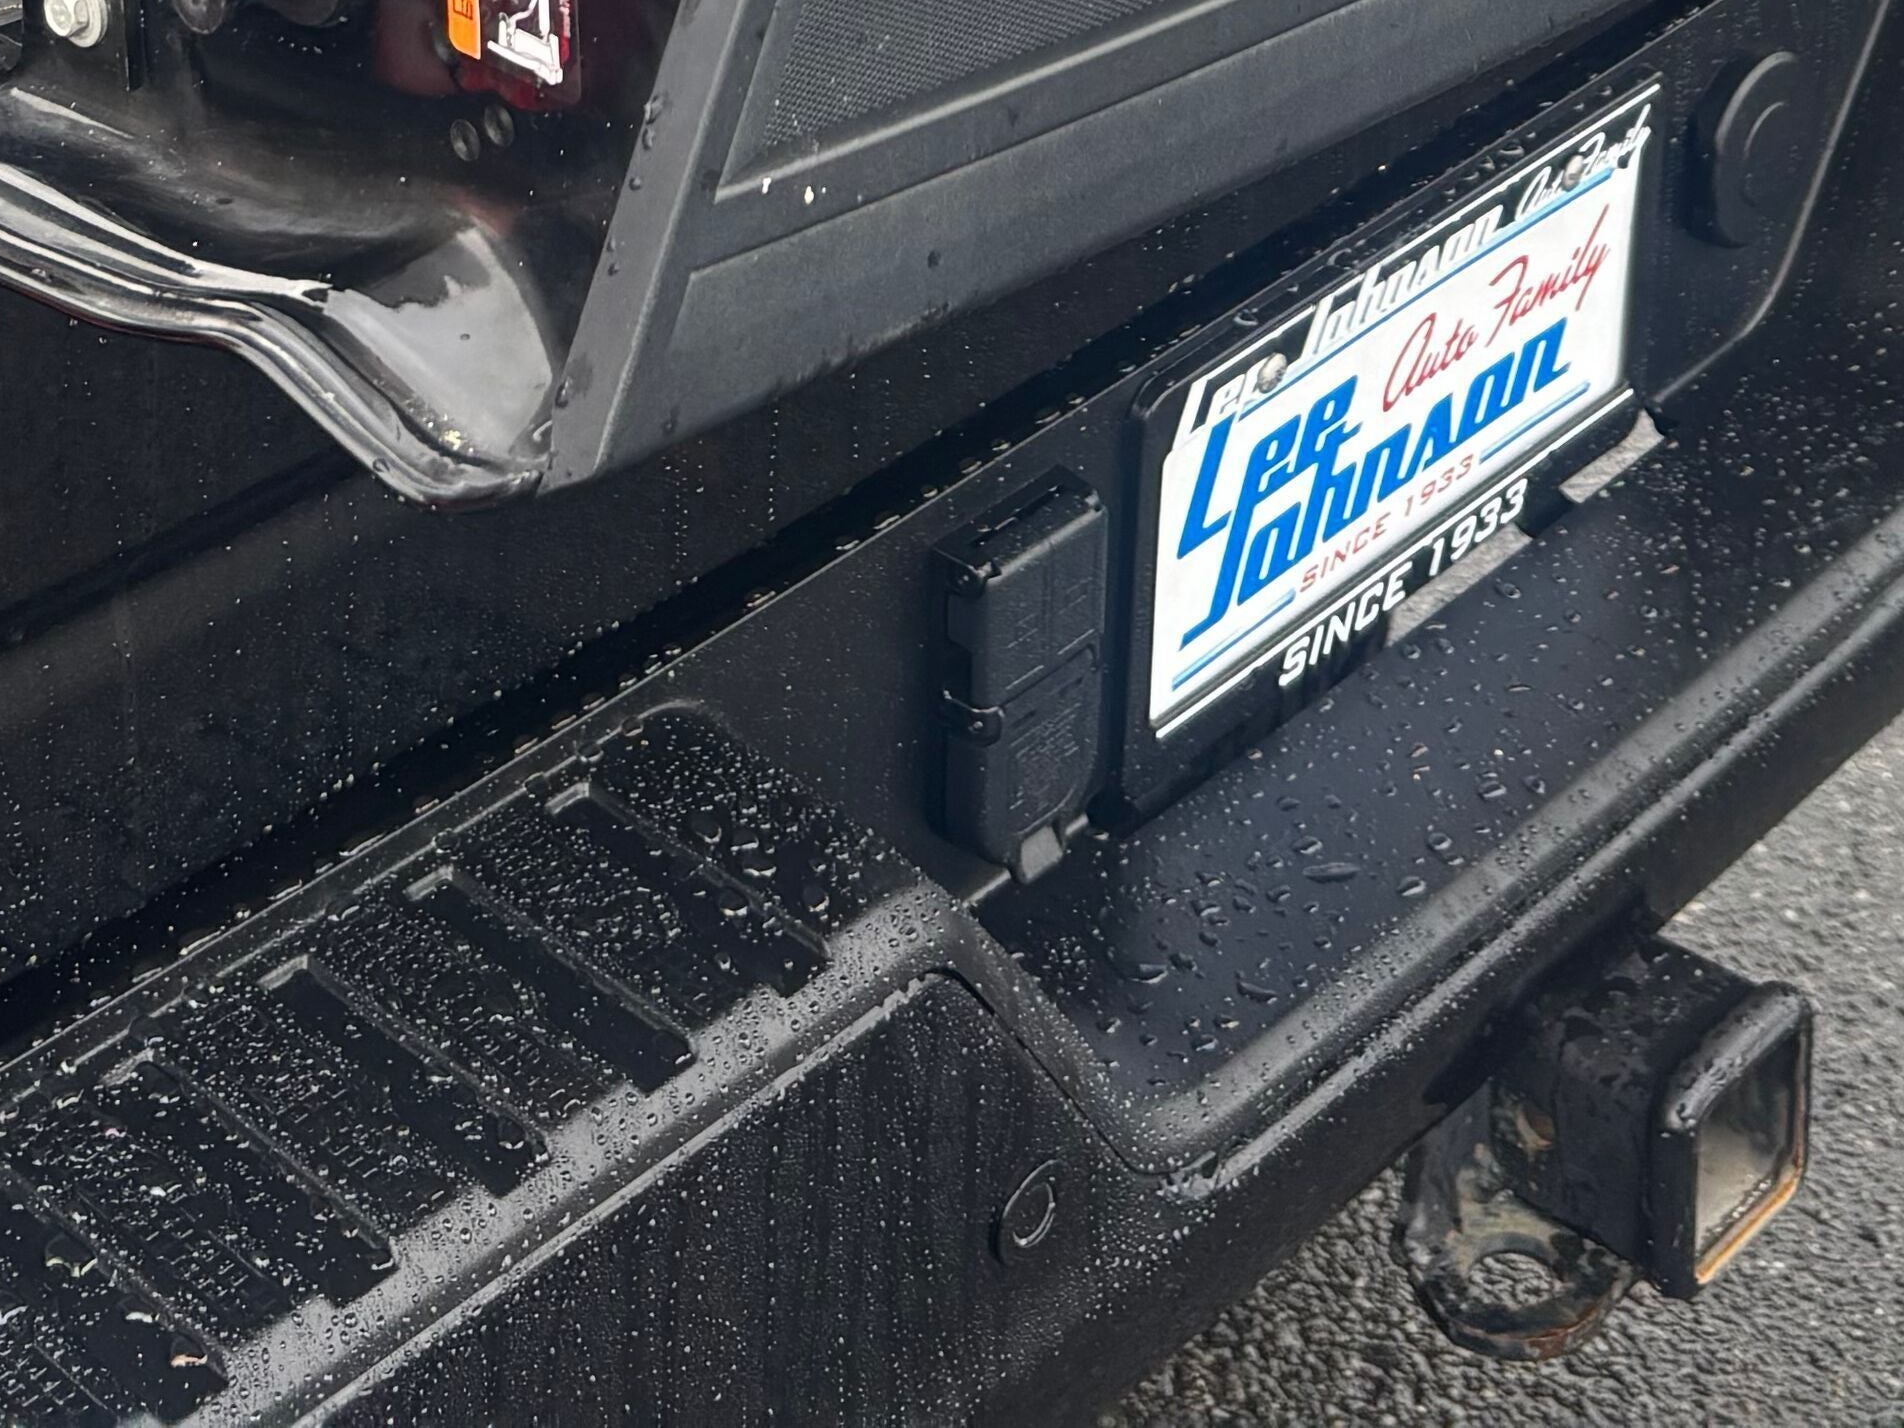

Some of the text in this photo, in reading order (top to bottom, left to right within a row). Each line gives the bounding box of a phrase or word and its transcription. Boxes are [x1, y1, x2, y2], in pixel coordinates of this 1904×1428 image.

[1296, 204, 1504, 361] Johnson
[1382, 203, 1611, 412] Auto Family
[1176, 374, 1362, 559] Lee
[1178, 316, 1572, 652] Johnson
[1299, 453, 1474, 593] SINCE 1933
[1277, 477, 1529, 687] SINCE 1933
